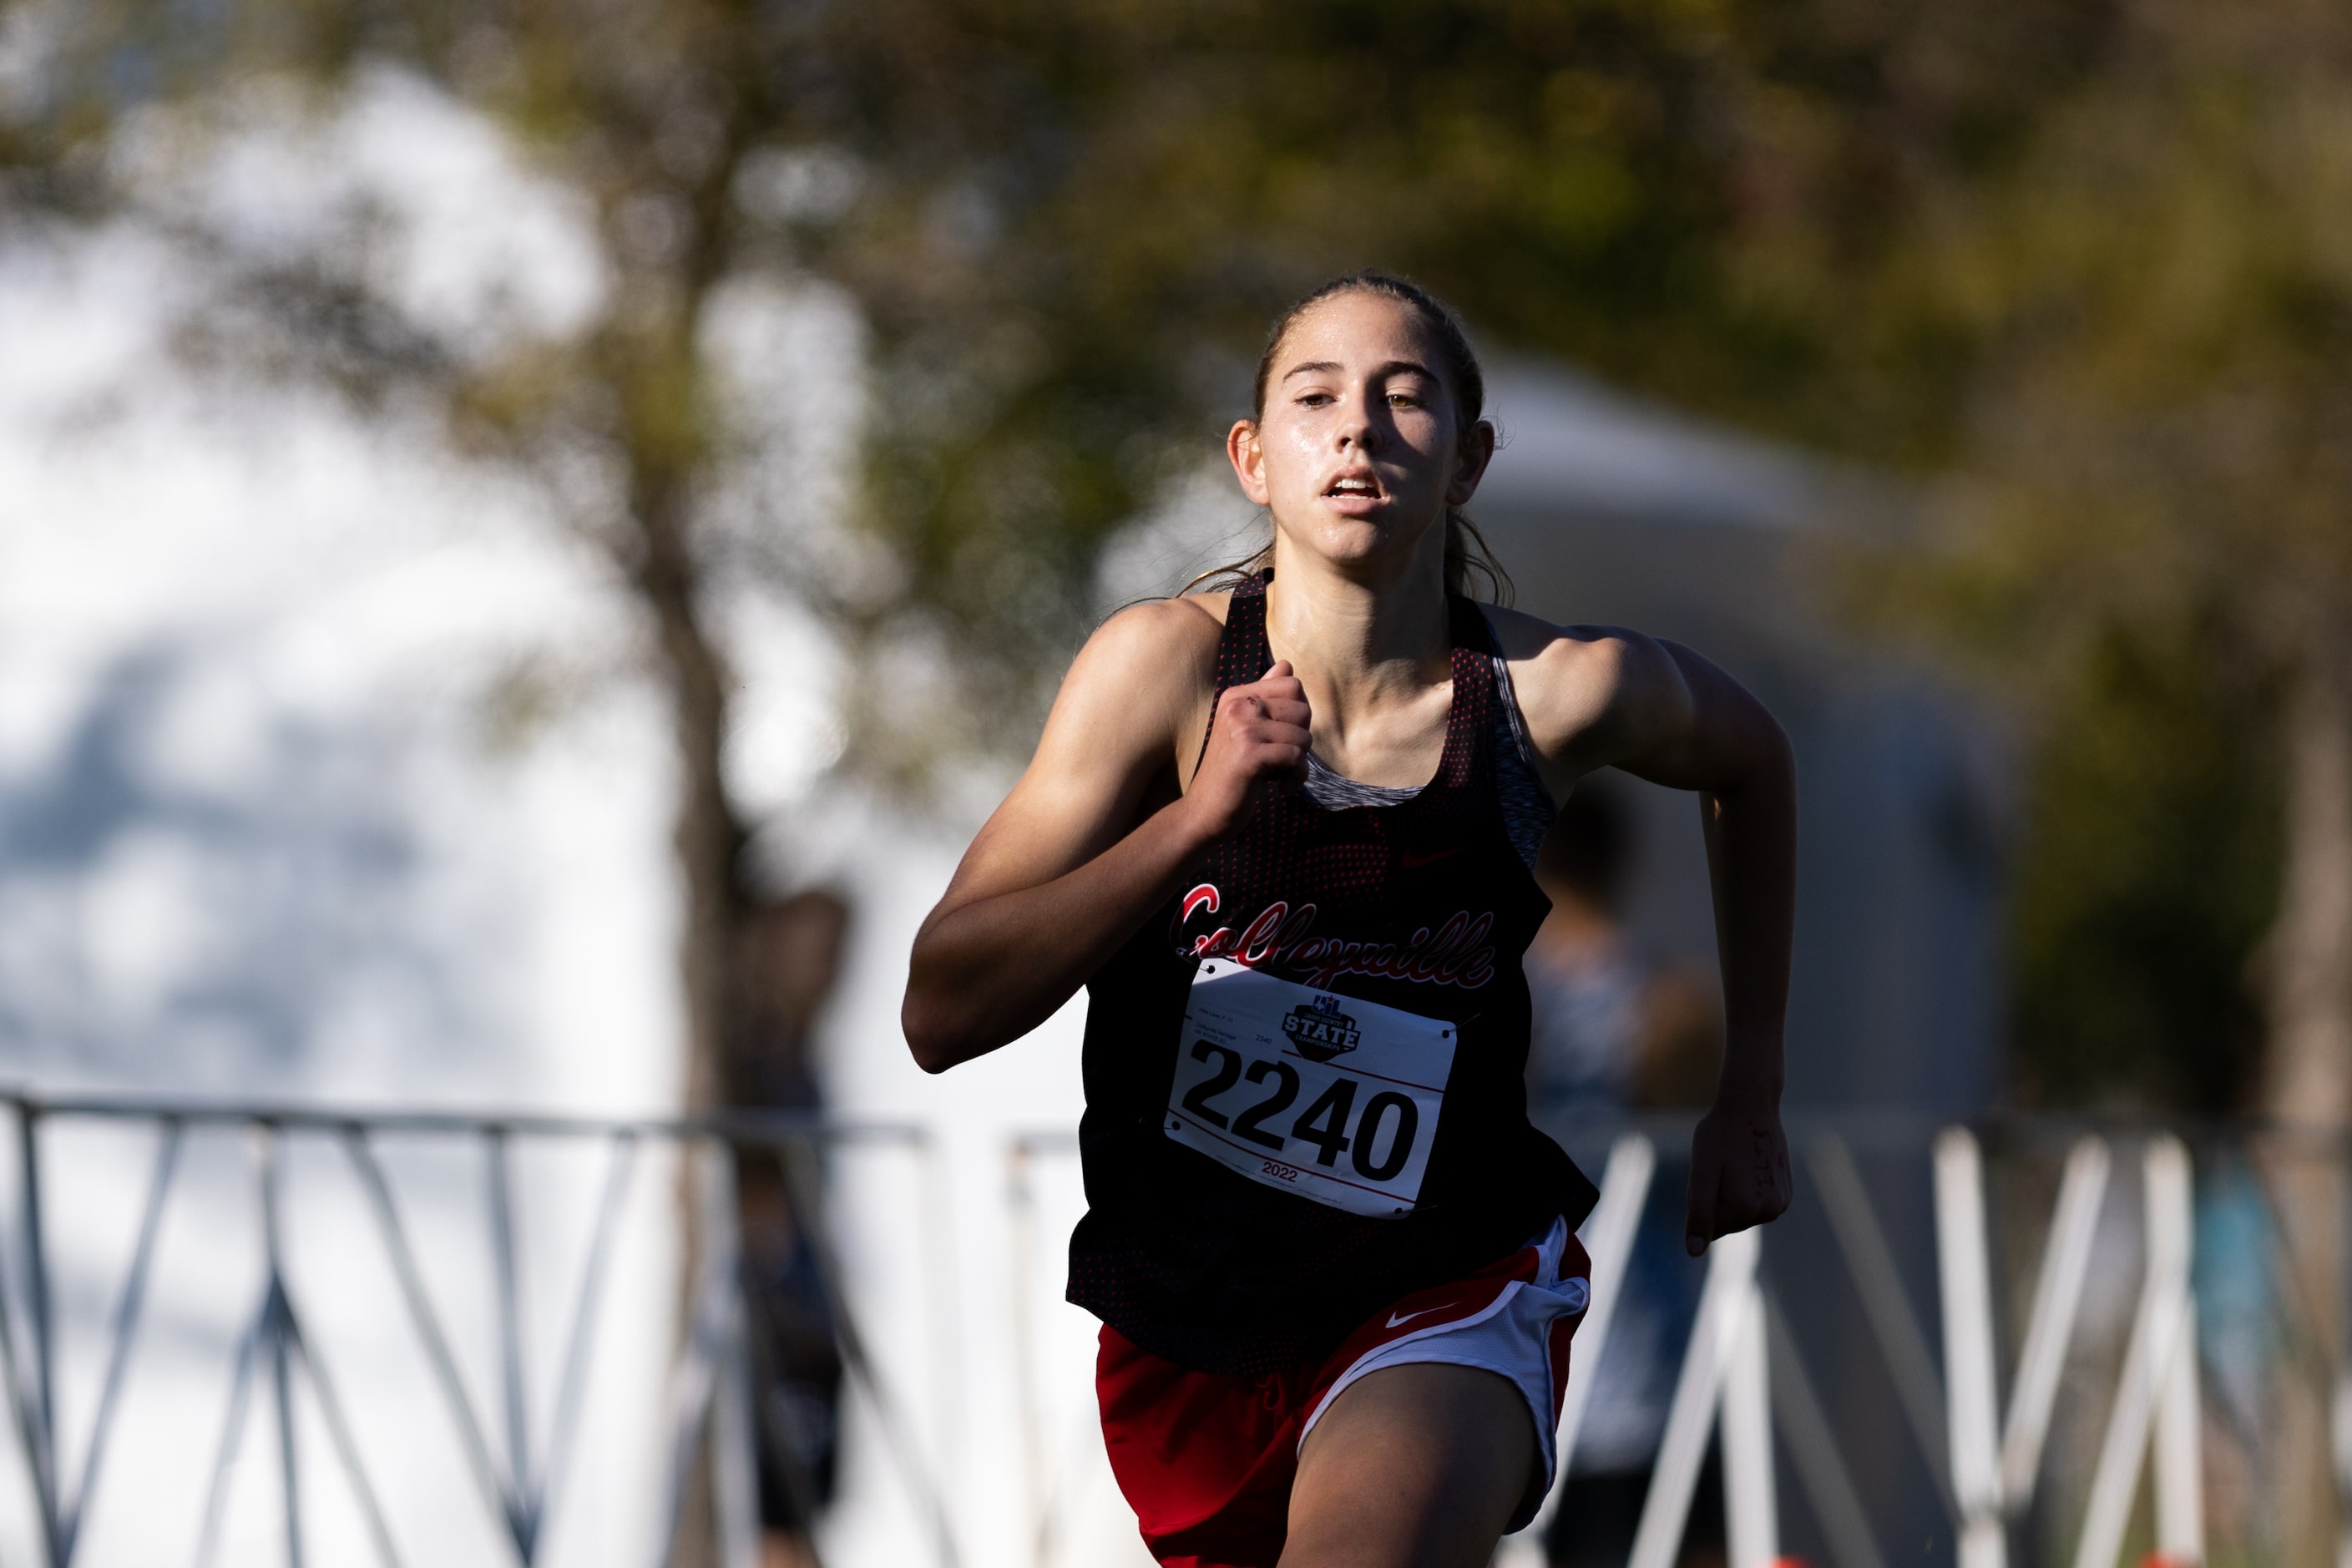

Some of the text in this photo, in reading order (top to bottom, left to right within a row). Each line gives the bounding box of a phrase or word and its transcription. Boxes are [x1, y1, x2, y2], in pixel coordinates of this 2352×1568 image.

[1168, 883, 1496, 990] Colleyville
[1284, 1015, 1358, 1048] STATE
[1321, 1018, 1344, 1027] COUNTRY
[1255, 1034, 1272, 1044] 2240
[1181, 1039, 1419, 1181] 2240
[1262, 1161, 1297, 1182] 2022
